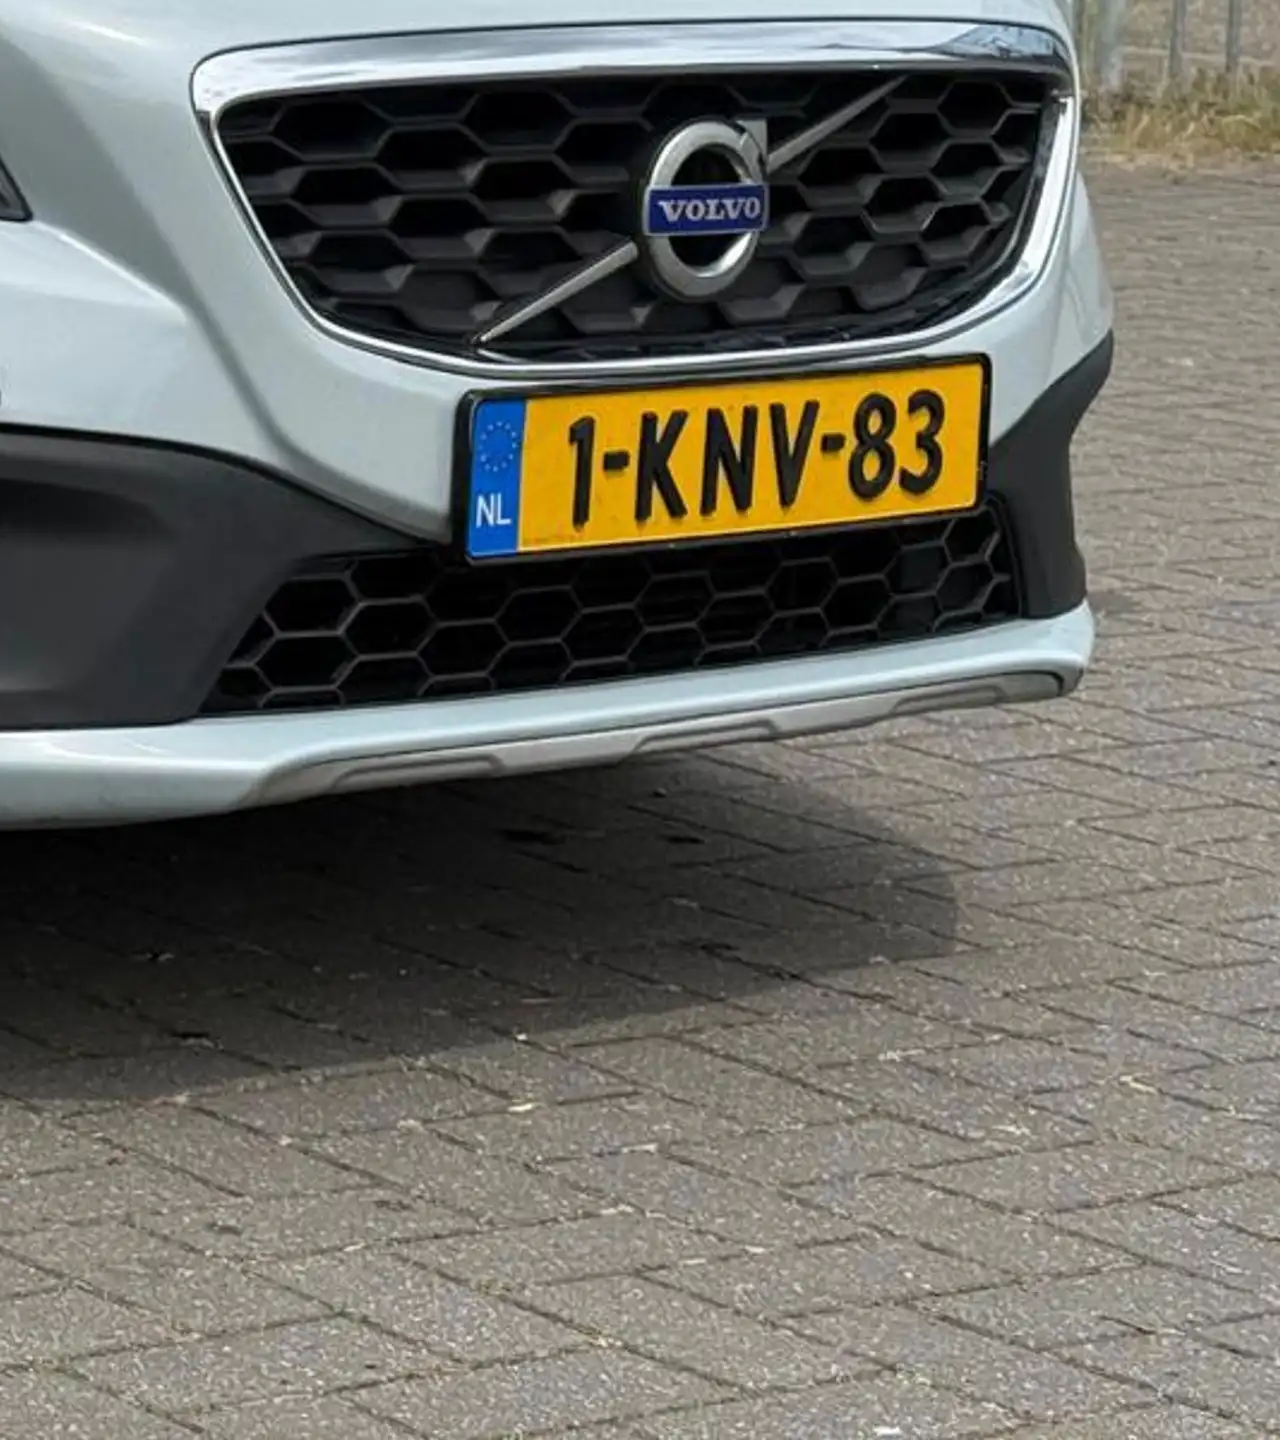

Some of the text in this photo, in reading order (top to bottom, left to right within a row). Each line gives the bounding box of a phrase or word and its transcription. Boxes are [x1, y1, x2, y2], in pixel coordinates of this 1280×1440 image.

[657, 196, 761, 223] VOLVO
[567, 388, 946, 532] 1-KNV-83
[475, 496, 512, 529] NL
